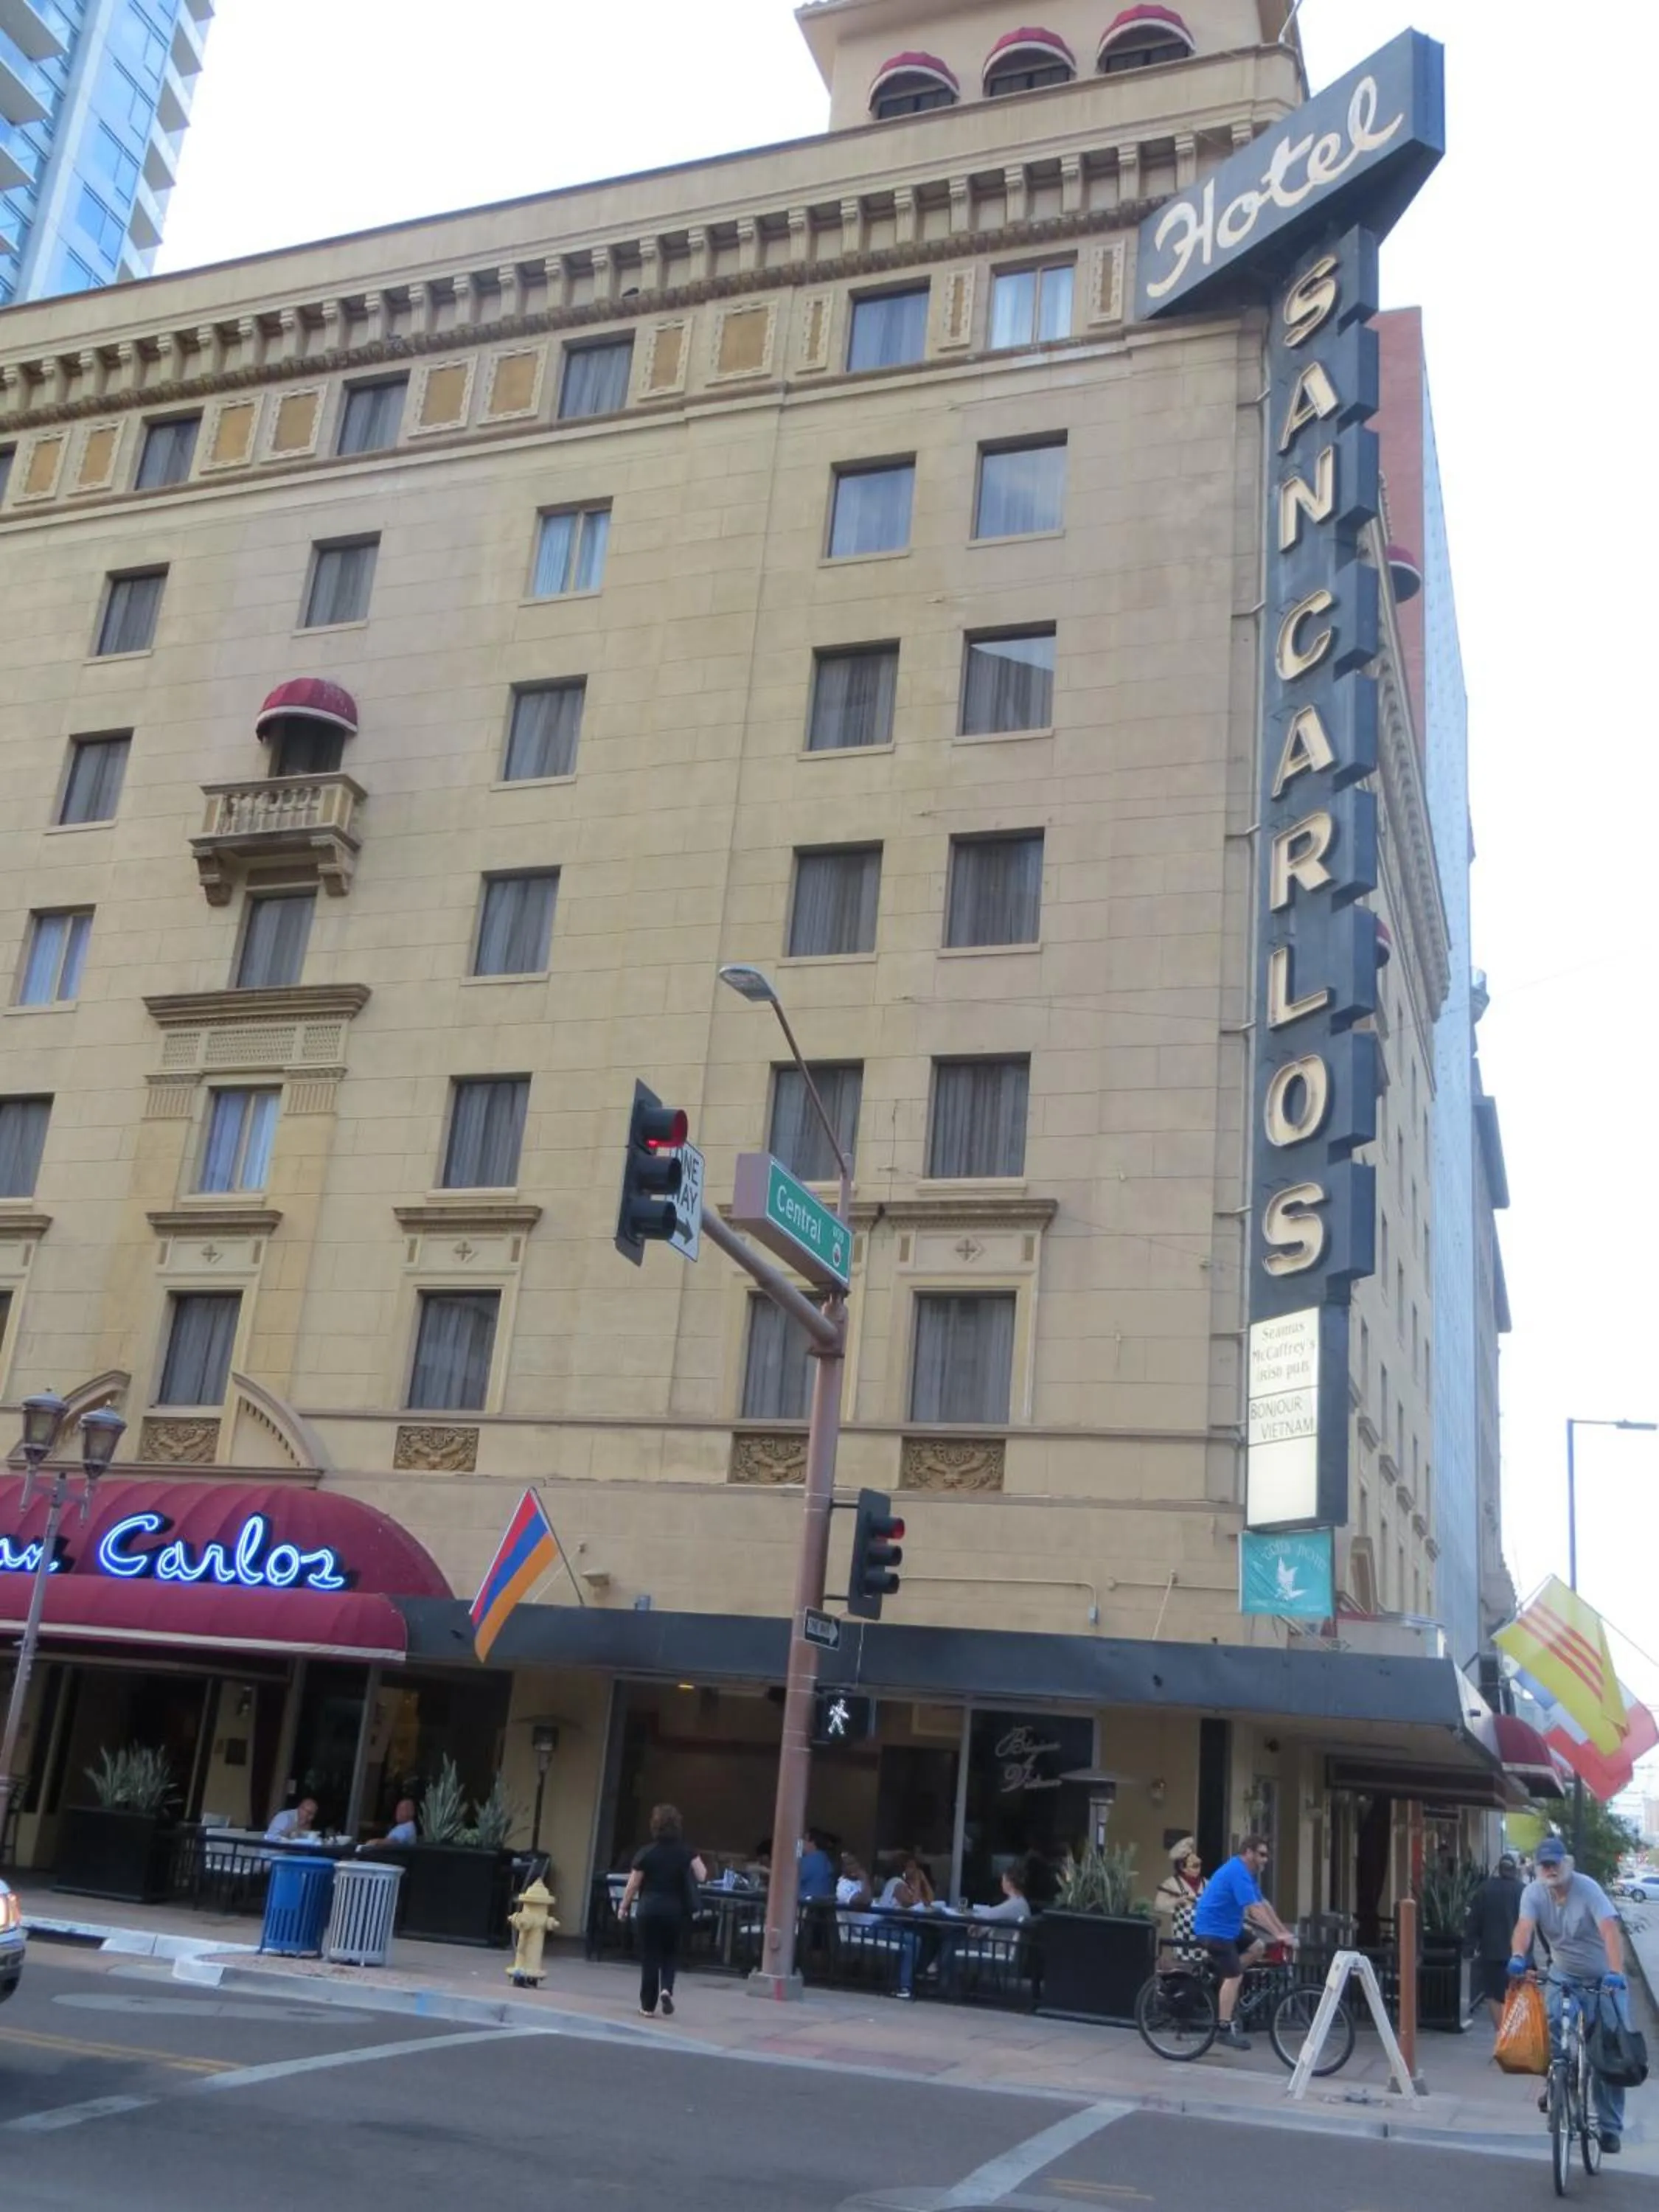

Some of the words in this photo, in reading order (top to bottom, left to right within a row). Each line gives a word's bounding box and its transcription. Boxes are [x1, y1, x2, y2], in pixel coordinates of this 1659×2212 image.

[1147, 74, 1404, 298] Hotel
[1278, 254, 1340, 553] SAN
[1262, 588, 1335, 1277] CARLOS
[776, 1185, 821, 1244] Central
[1250, 1395, 1303, 1420] BONJOUR
[1260, 1416, 1314, 1440] VIETNAM
[99, 1512, 346, 1590] Carlos
